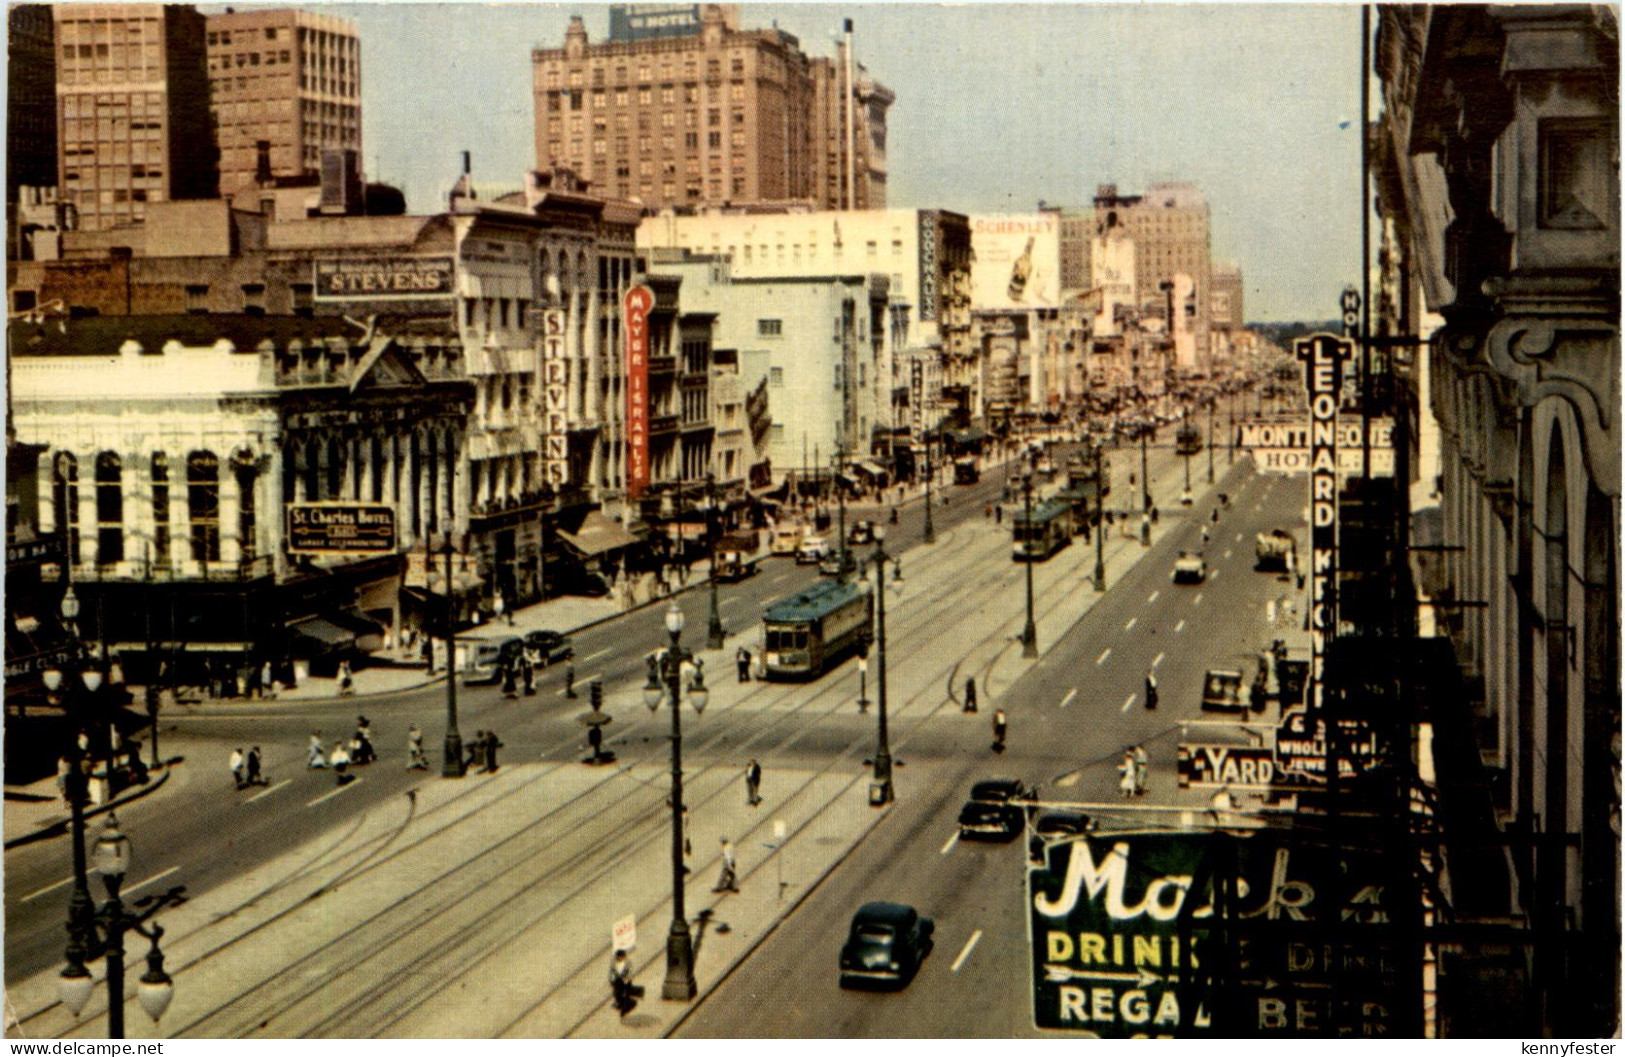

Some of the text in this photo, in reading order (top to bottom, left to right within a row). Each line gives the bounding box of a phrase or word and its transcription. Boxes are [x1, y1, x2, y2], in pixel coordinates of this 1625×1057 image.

[330, 271, 441, 291] STEVENS
[546, 312, 565, 483] STEVENS
[1313, 340, 1335, 528] LEONARD
[1266, 453, 1350, 468] HOTL
[1059, 985, 1212, 1027] REGAL
